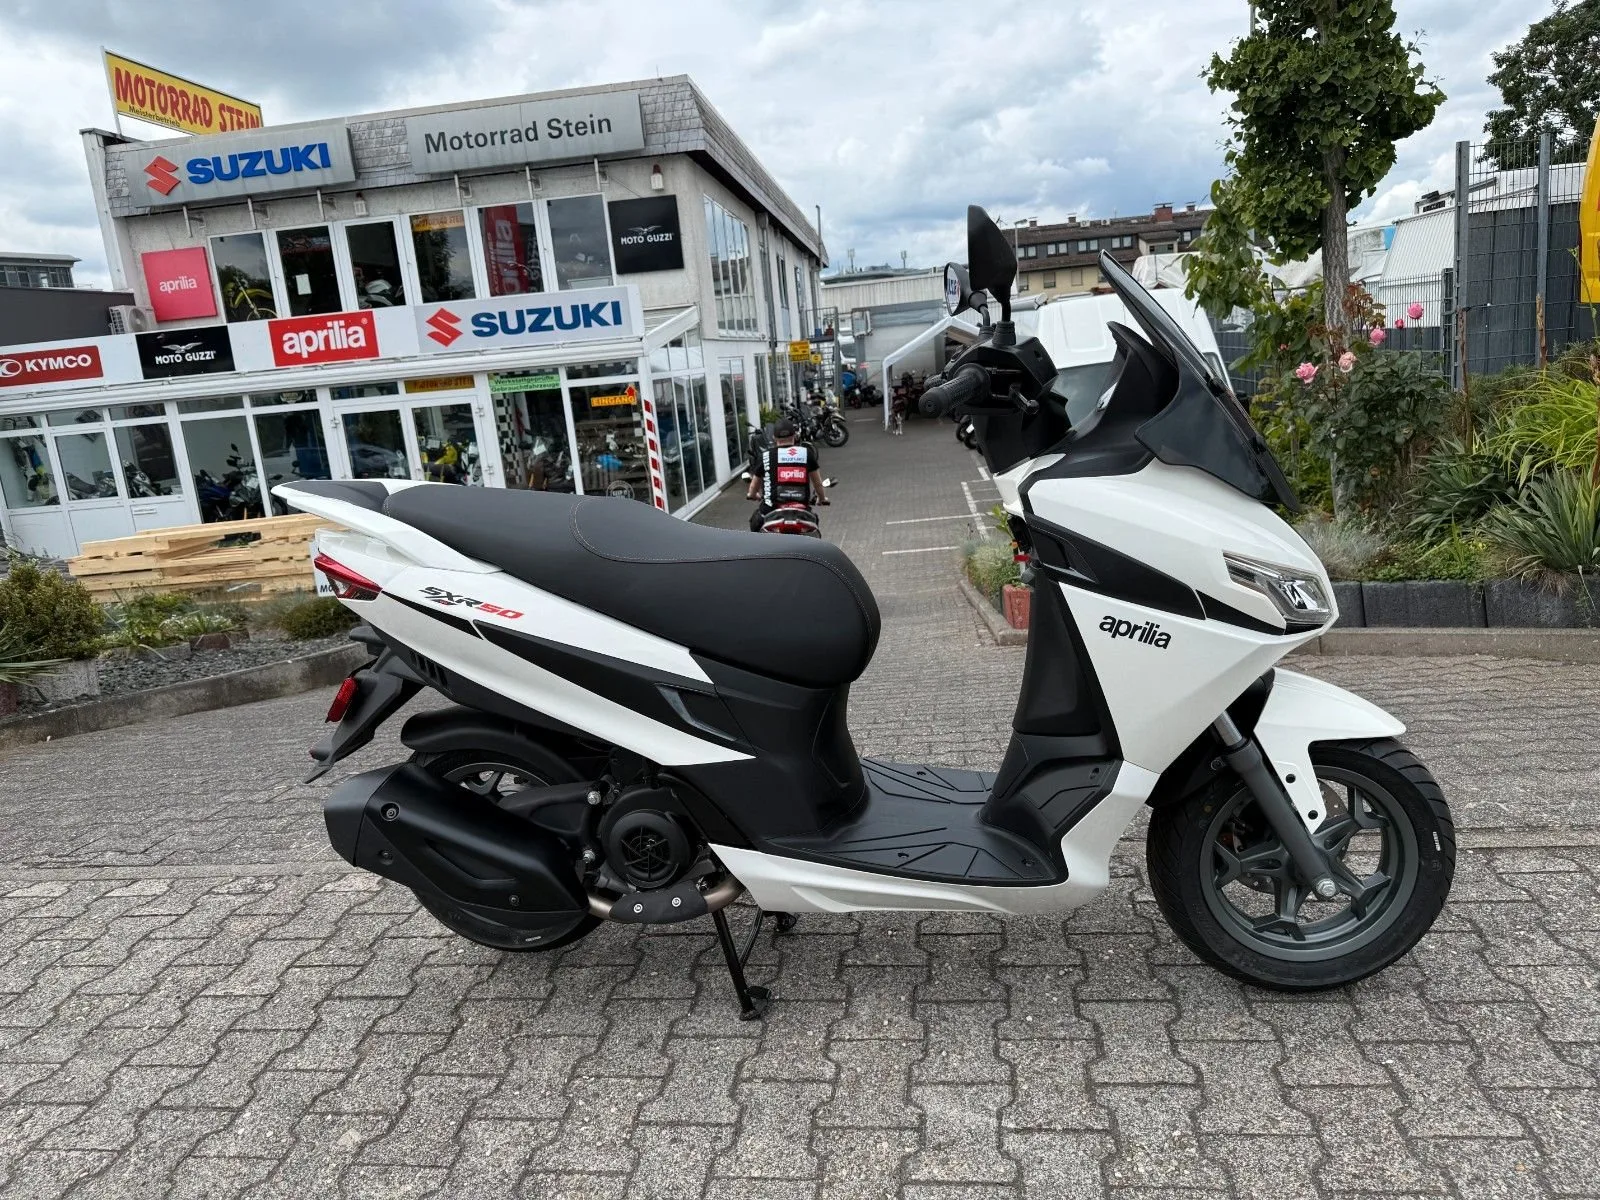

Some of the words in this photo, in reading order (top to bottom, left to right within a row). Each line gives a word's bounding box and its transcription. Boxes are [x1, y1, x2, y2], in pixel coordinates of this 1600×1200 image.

[114, 67, 213, 128] MOTORRAD
[218, 103, 260, 132] STEIN
[128, 105, 180, 127] Meisterbetrieb
[425, 121, 538, 153] Motorrad
[547, 114, 612, 140] Stein
[186, 143, 331, 184] SUZUKI
[620, 236, 645, 245] MOTO
[646, 233, 673, 242] GUZZI
[159, 275, 197, 294] aprilia
[471, 301, 622, 337] SUZUKI
[282, 320, 367, 358] aprilia
[25, 354, 92, 372] KYMCO
[155, 354, 183, 365] MOTO
[184, 351, 215, 362] GUZZI
[780, 470, 804, 479] aprilia
[1099, 615, 1171, 649] aprilia
